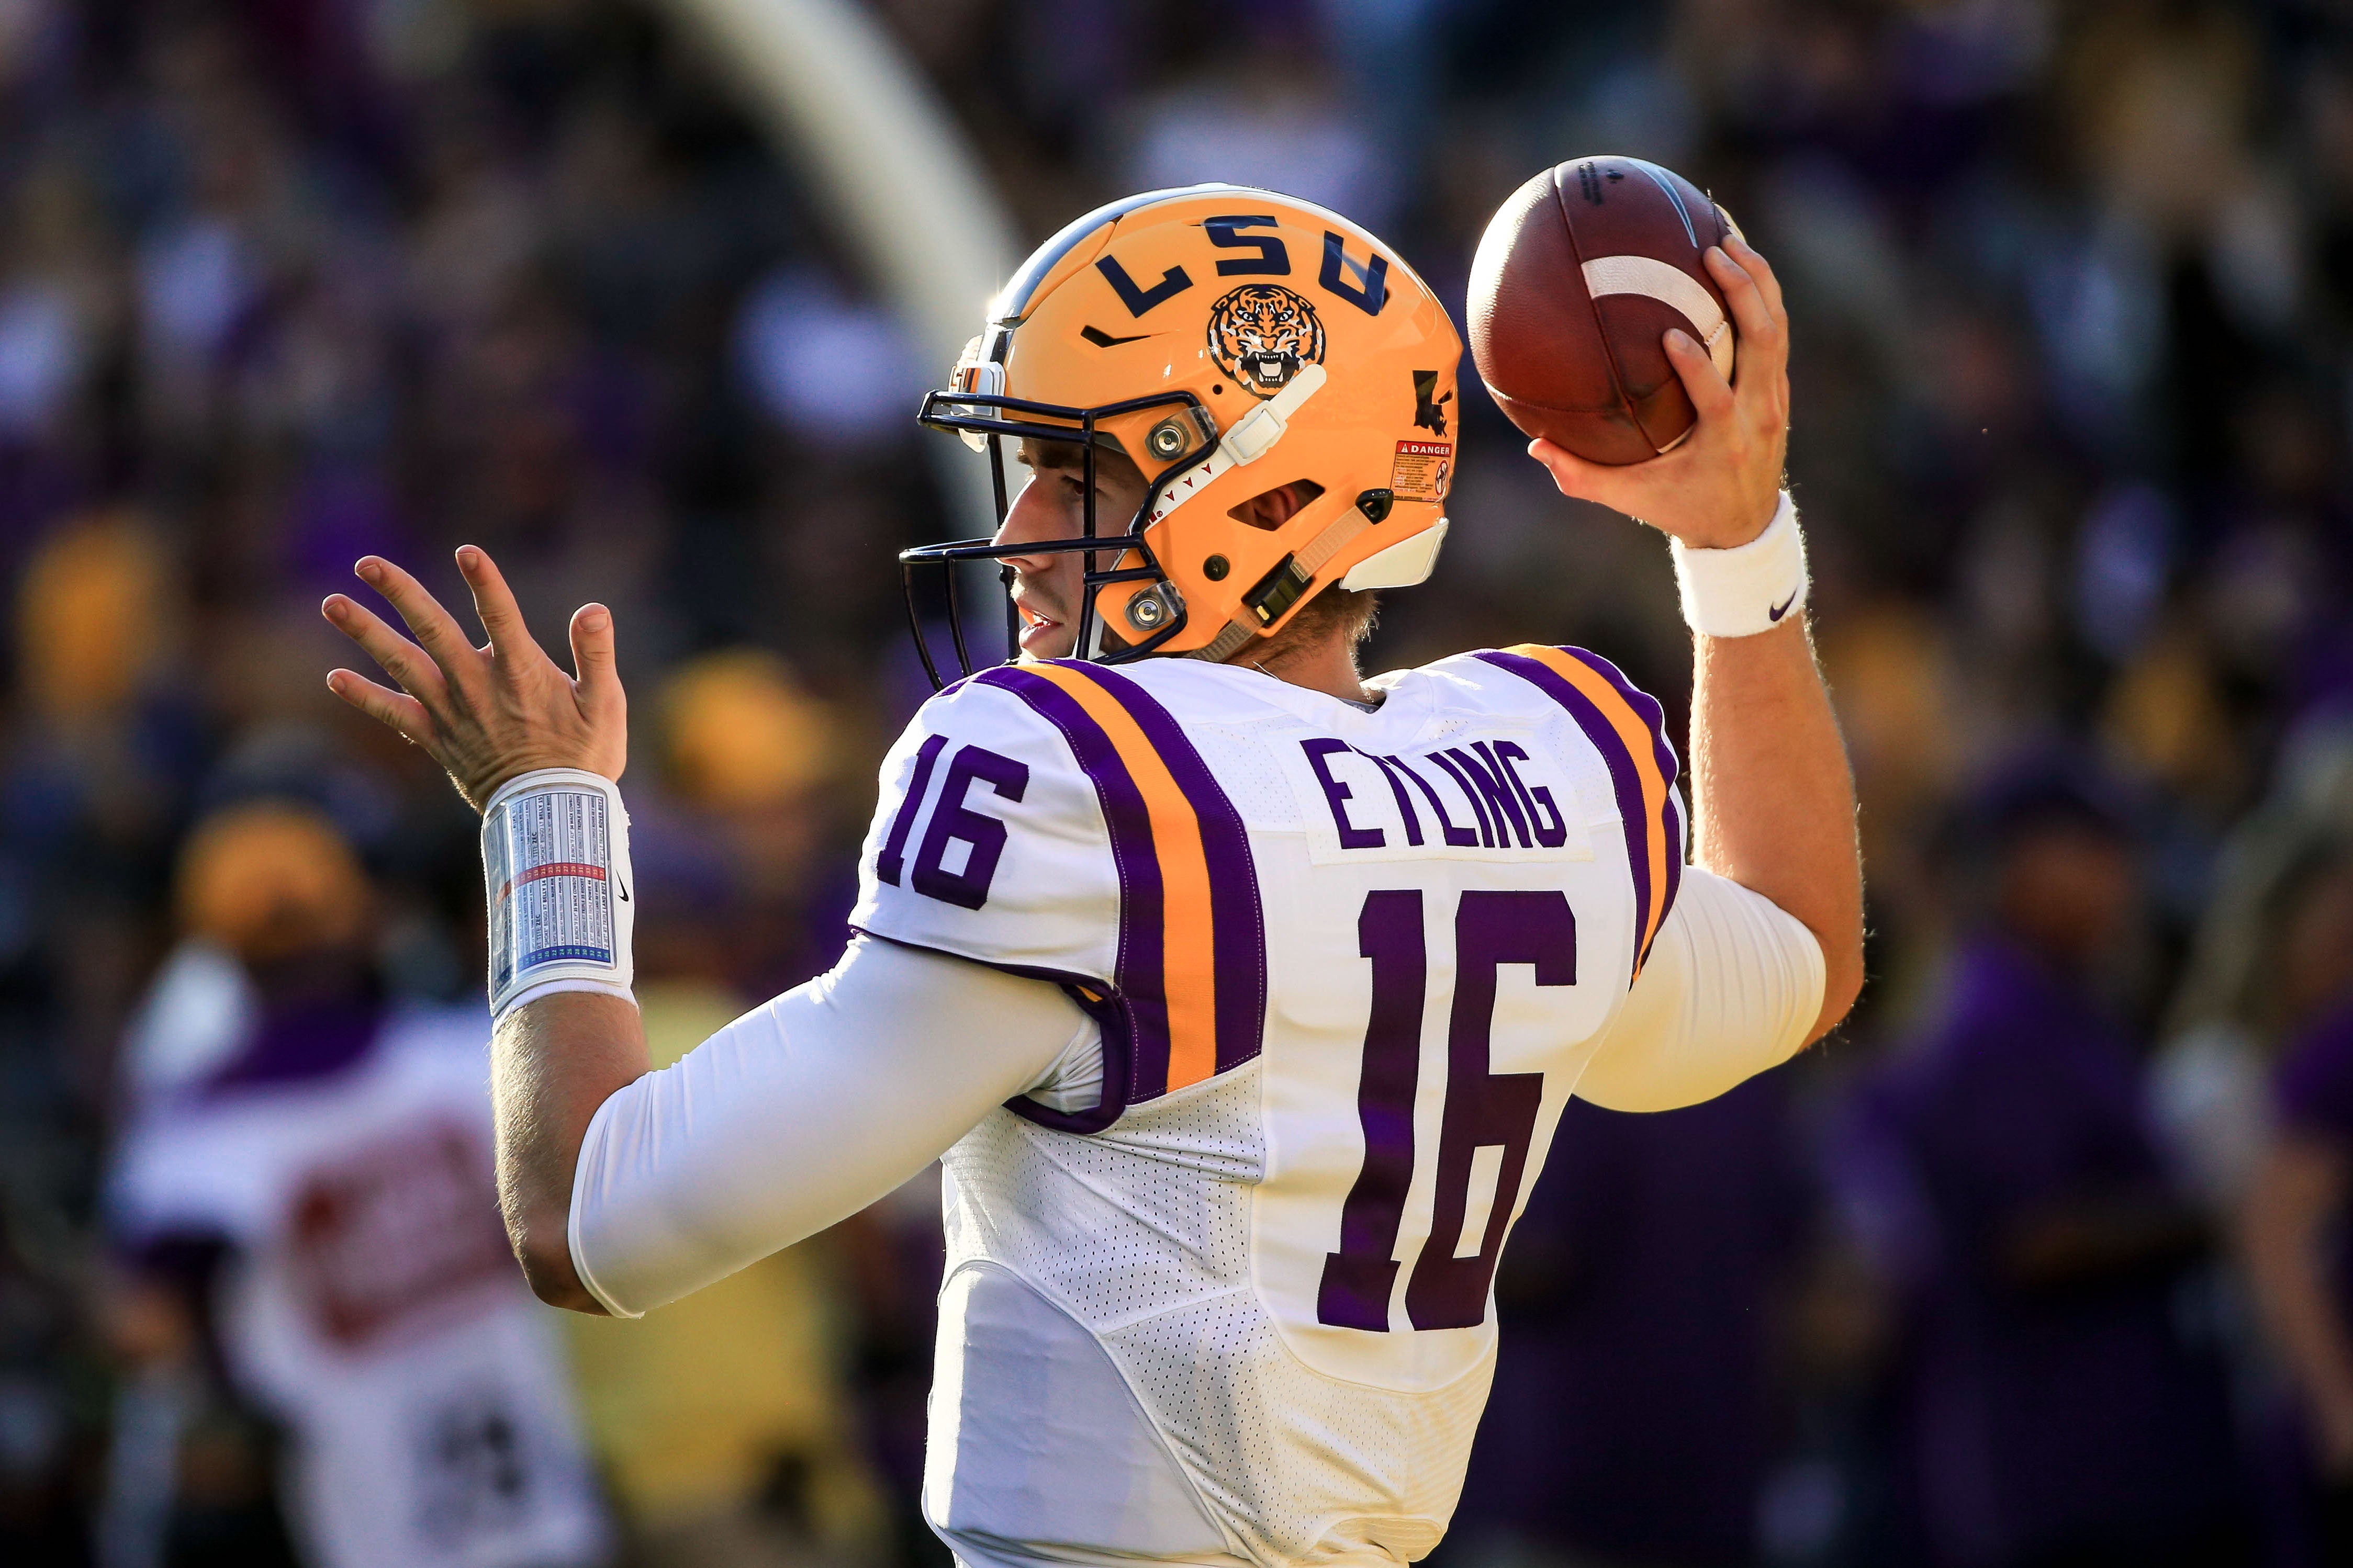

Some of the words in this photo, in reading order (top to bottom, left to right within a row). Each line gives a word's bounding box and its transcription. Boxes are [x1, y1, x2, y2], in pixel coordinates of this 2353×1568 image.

[1096, 216, 1388, 318] LSU
[1410, 445, 1450, 455] DANGER
[877, 734, 1029, 911] 16
[1299, 738, 1567, 849] ETLING
[1317, 889, 1577, 1333] 16
